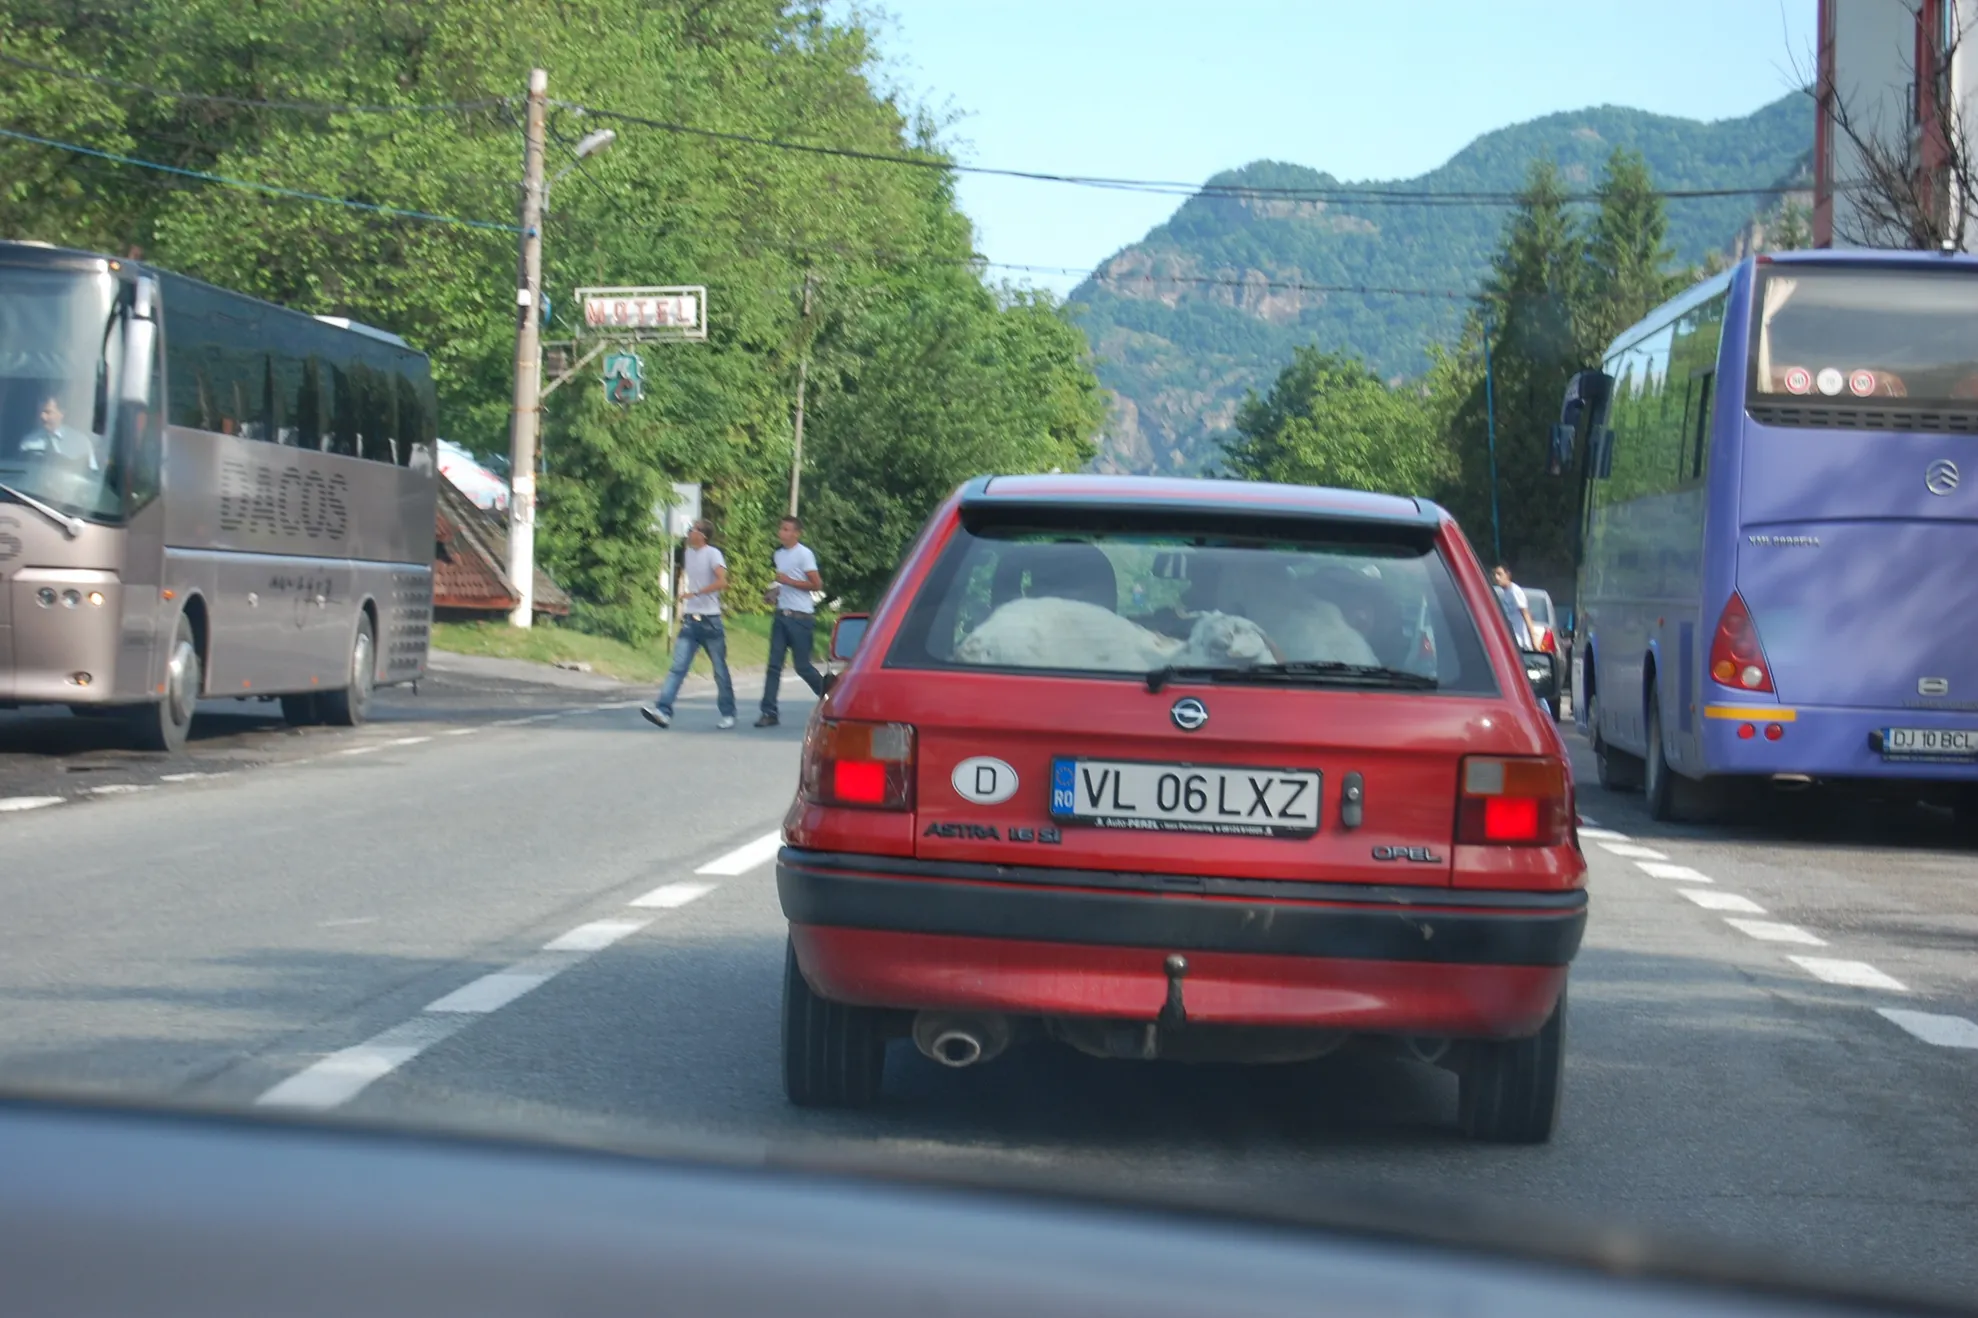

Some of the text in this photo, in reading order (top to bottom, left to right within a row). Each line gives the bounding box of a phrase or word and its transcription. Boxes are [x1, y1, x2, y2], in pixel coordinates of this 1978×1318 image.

[587, 297, 690, 326] MOTEL
[1894, 731, 1975, 750] DJ 10 BCL
[975, 766, 997, 795] D
[1054, 789, 1073, 808] RO
[1082, 767, 1308, 819] VL 06 LXZ
[923, 821, 1001, 841] ASTRA
[1372, 846, 1442, 864] OPEL
